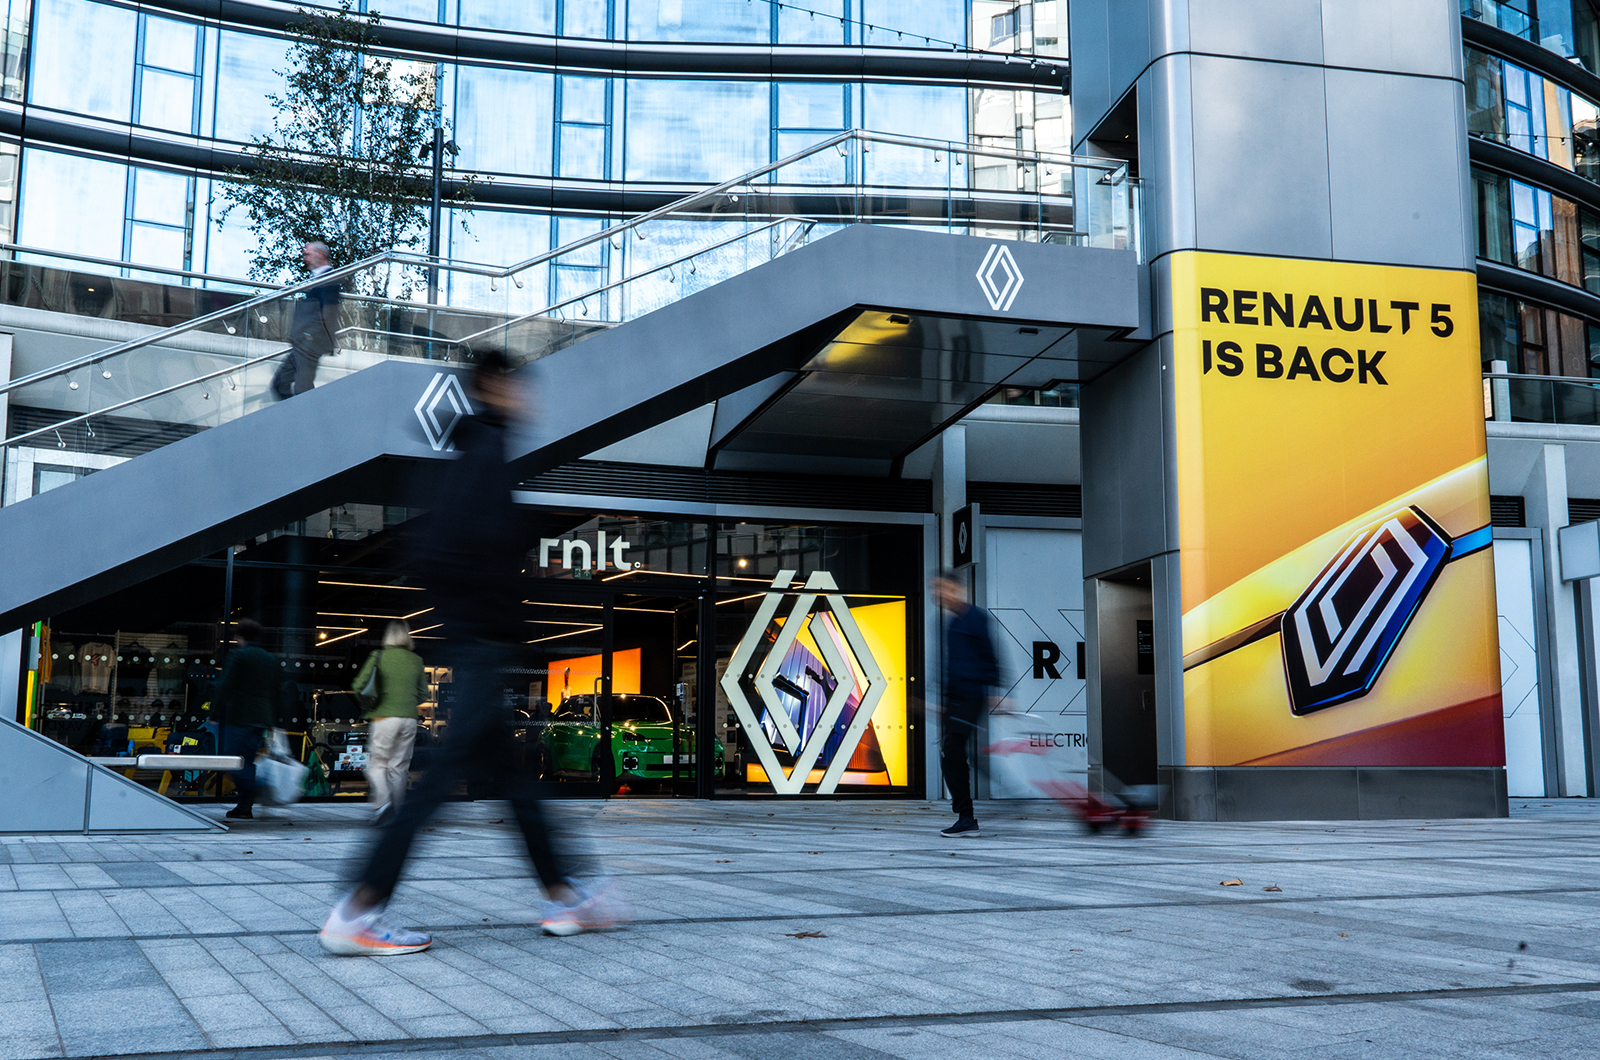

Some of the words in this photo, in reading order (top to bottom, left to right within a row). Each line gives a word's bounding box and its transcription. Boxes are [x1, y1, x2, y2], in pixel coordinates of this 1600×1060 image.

[1200, 287, 1420, 336] RENAULT
[1430, 303, 1454, 338] 5
[1202, 339, 1244, 377] IS
[1255, 343, 1389, 386] BACK
[1030, 732, 1089, 748] ELECTRI
